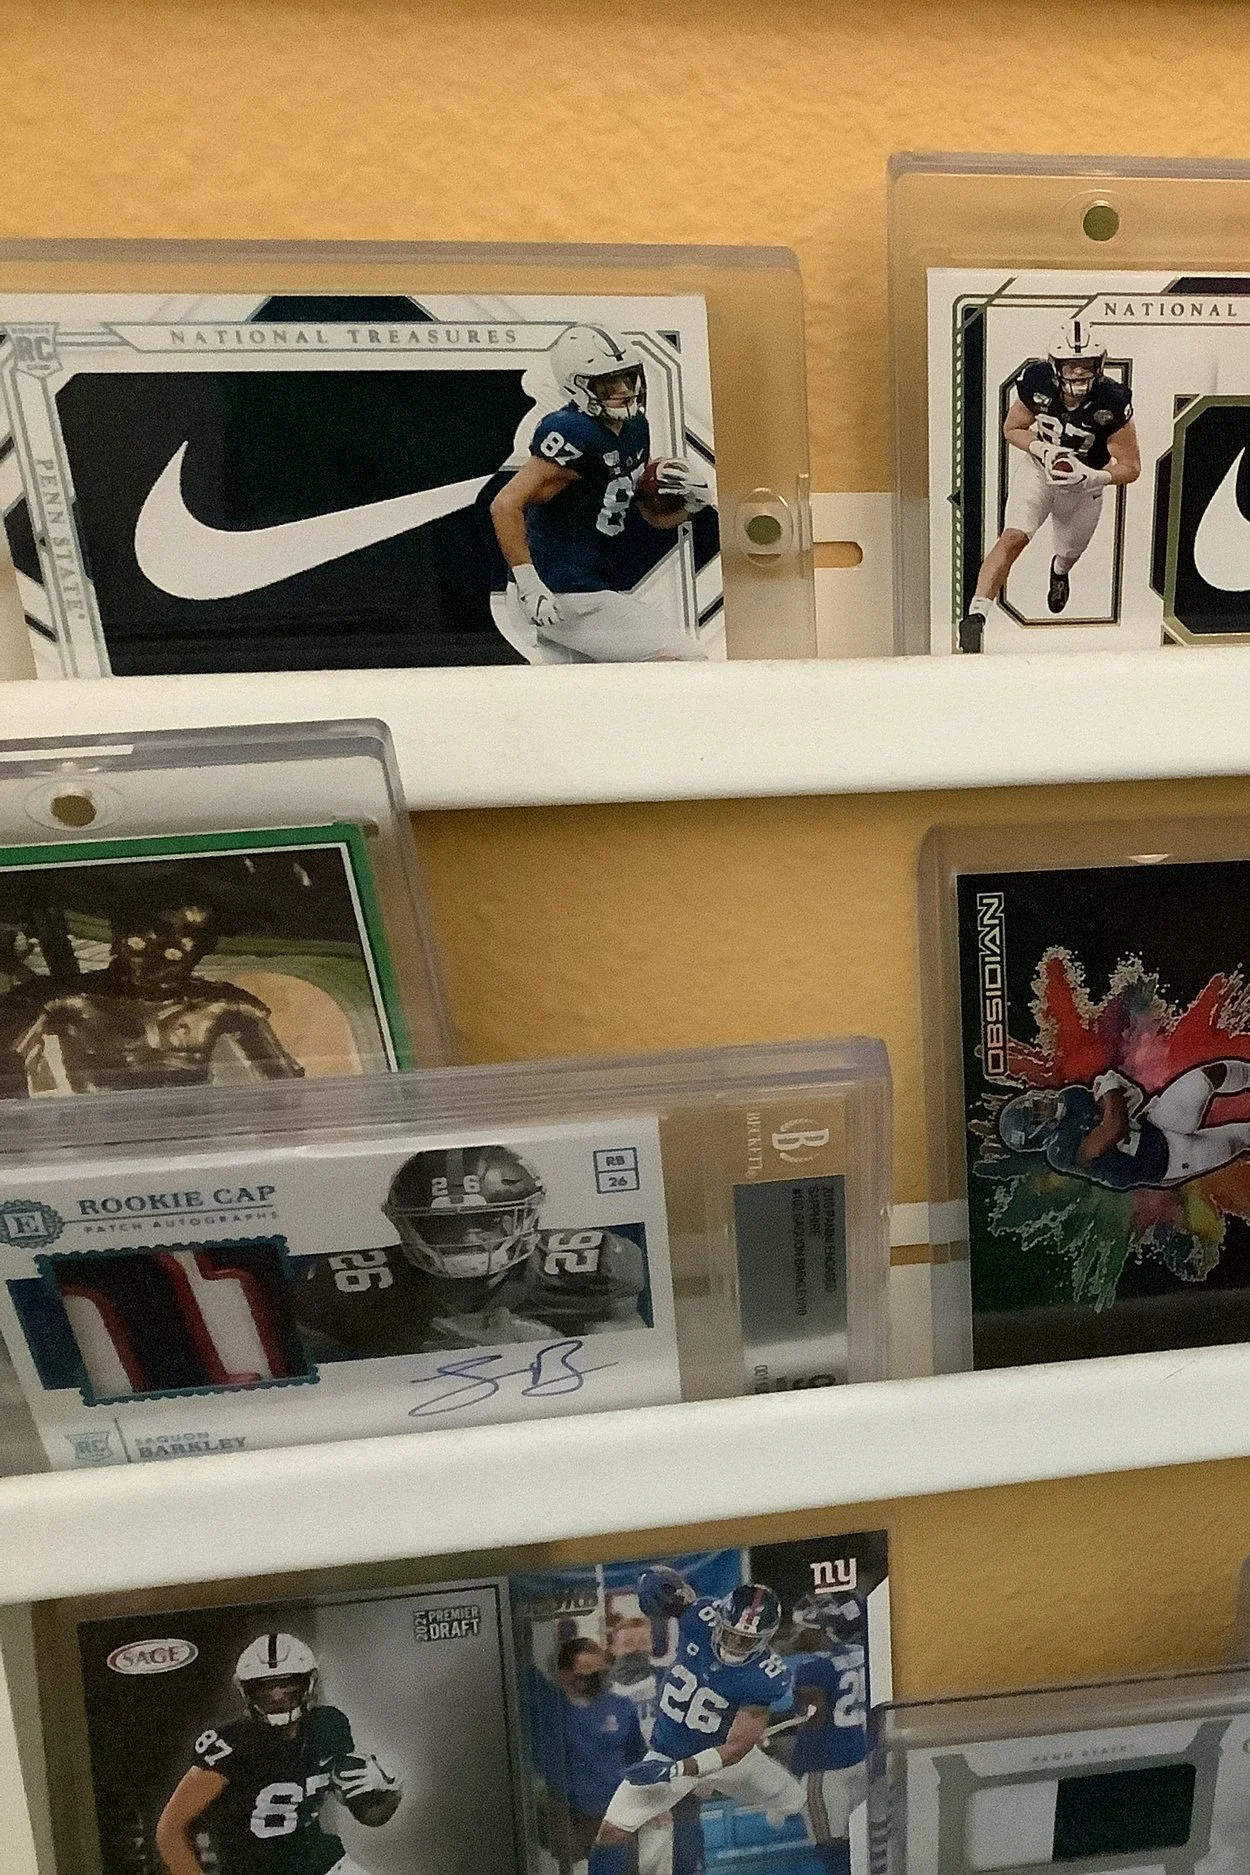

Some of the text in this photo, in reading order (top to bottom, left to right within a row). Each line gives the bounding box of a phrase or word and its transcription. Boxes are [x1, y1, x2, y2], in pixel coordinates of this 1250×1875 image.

[1103, 301, 1238, 318] NATIONAL
[17, 335, 52, 362] RC
[169, 328, 518, 346] NATIONAL TREASURES
[540, 431, 584, 467] 87
[596, 462, 646, 537] 8
[34, 458, 84, 612] PENN STATE
[981, 895, 1006, 1076] OBSIDIAN
[746, 1111, 763, 1171] BECKETT
[605, 1153, 626, 1168] RB
[607, 1175, 629, 1188] 26
[77, 1184, 276, 1216] ROOKIE CAP
[83, 1210, 281, 1236] PATCH AUTOGRAPHS
[138, 1436, 248, 1459] BARKLEY
[811, 1557, 859, 1595] ny
[427, 1606, 479, 1623] PREMIER
[429, 1618, 480, 1640] DRAFT
[121, 1644, 183, 1668] SAGE
[659, 1663, 730, 1734] 26
[194, 1729, 234, 1768] 87
